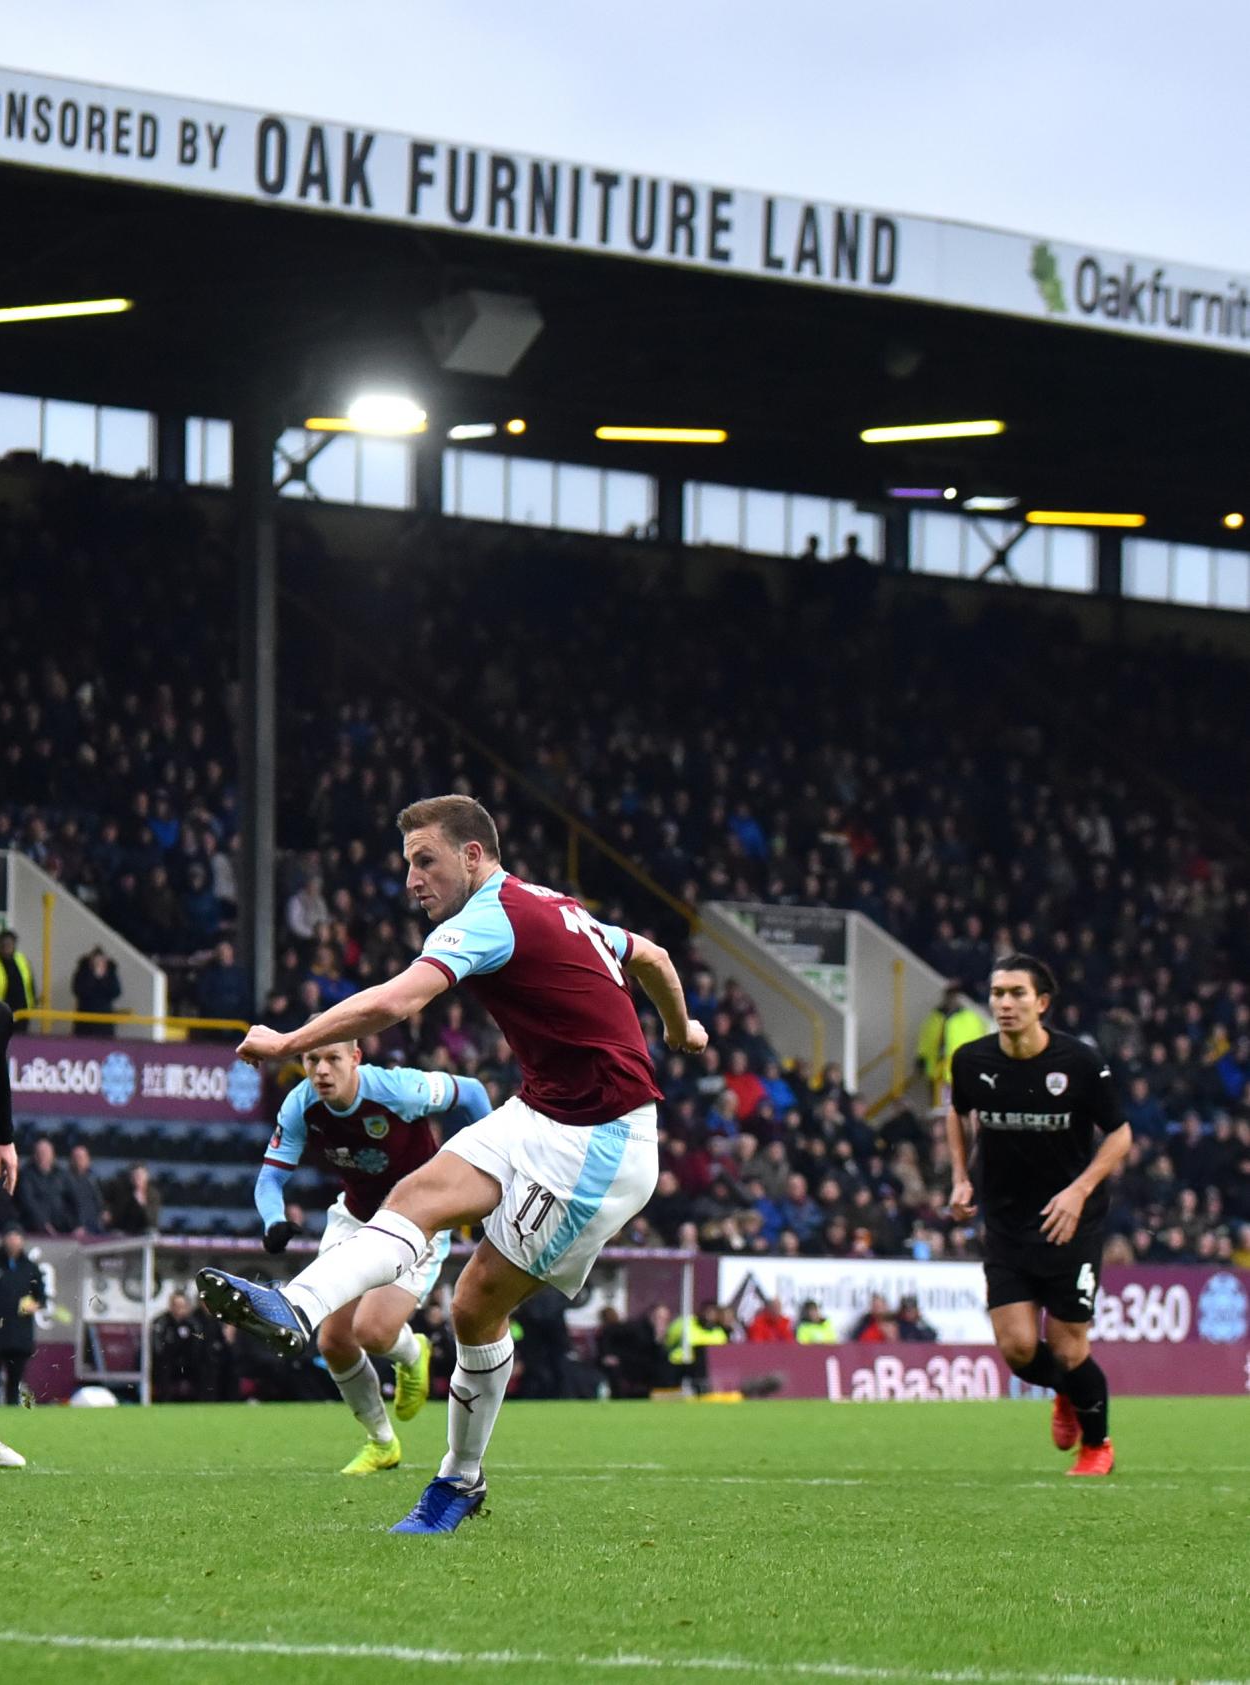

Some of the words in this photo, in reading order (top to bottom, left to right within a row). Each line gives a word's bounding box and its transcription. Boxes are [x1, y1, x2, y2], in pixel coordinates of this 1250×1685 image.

[177, 119, 227, 170] BY
[256, 116, 375, 209] OAK
[408, 141, 734, 263] FURNITURE
[761, 197, 898, 286] LAND
[516, 1182, 556, 1232] 11
[1076, 1262, 1096, 1298] 4
[825, 1355, 1000, 1403] LaBa360
